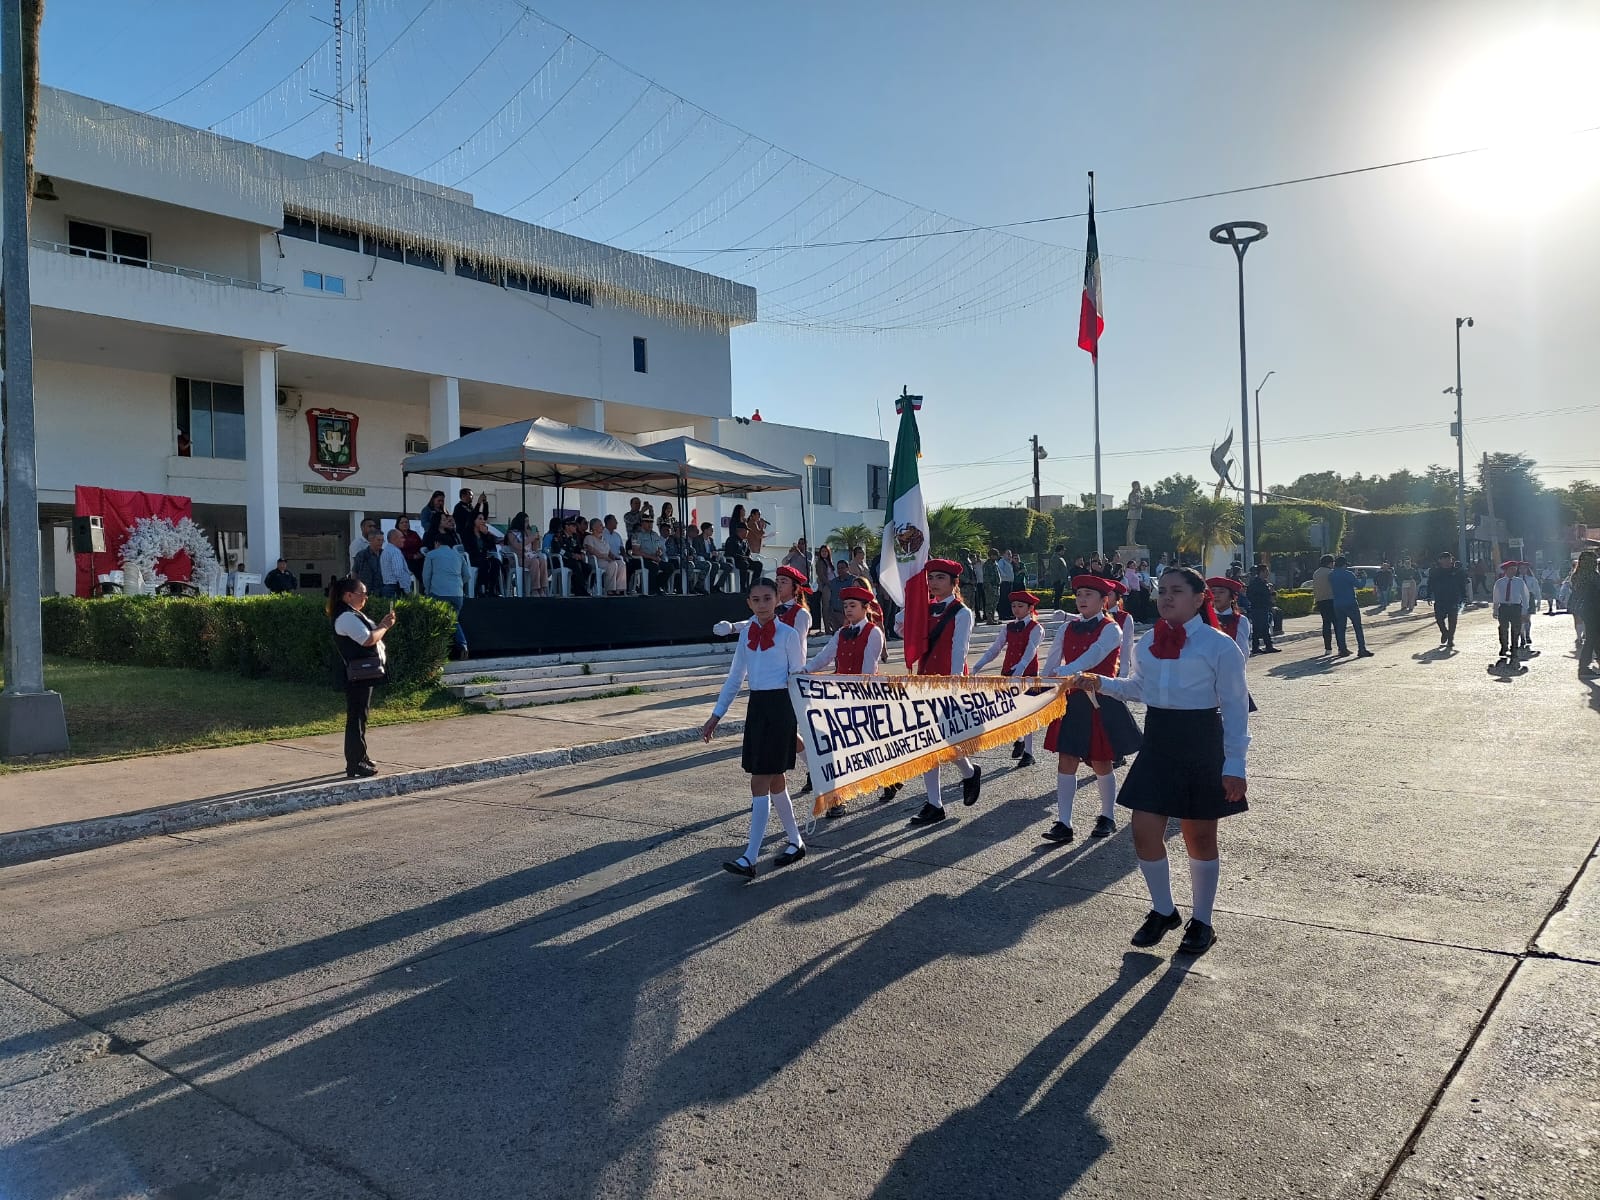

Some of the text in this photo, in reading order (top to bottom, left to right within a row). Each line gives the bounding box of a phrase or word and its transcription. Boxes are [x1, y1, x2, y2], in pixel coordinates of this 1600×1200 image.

[806, 686, 1020, 756] GABRIEL LEYVA SOLANO
[821, 756, 853, 782] VILLA
[850, 746, 885, 771] BENITO
[883, 733, 921, 761] JUAREZ
[974, 698, 1017, 726] SINALOA
